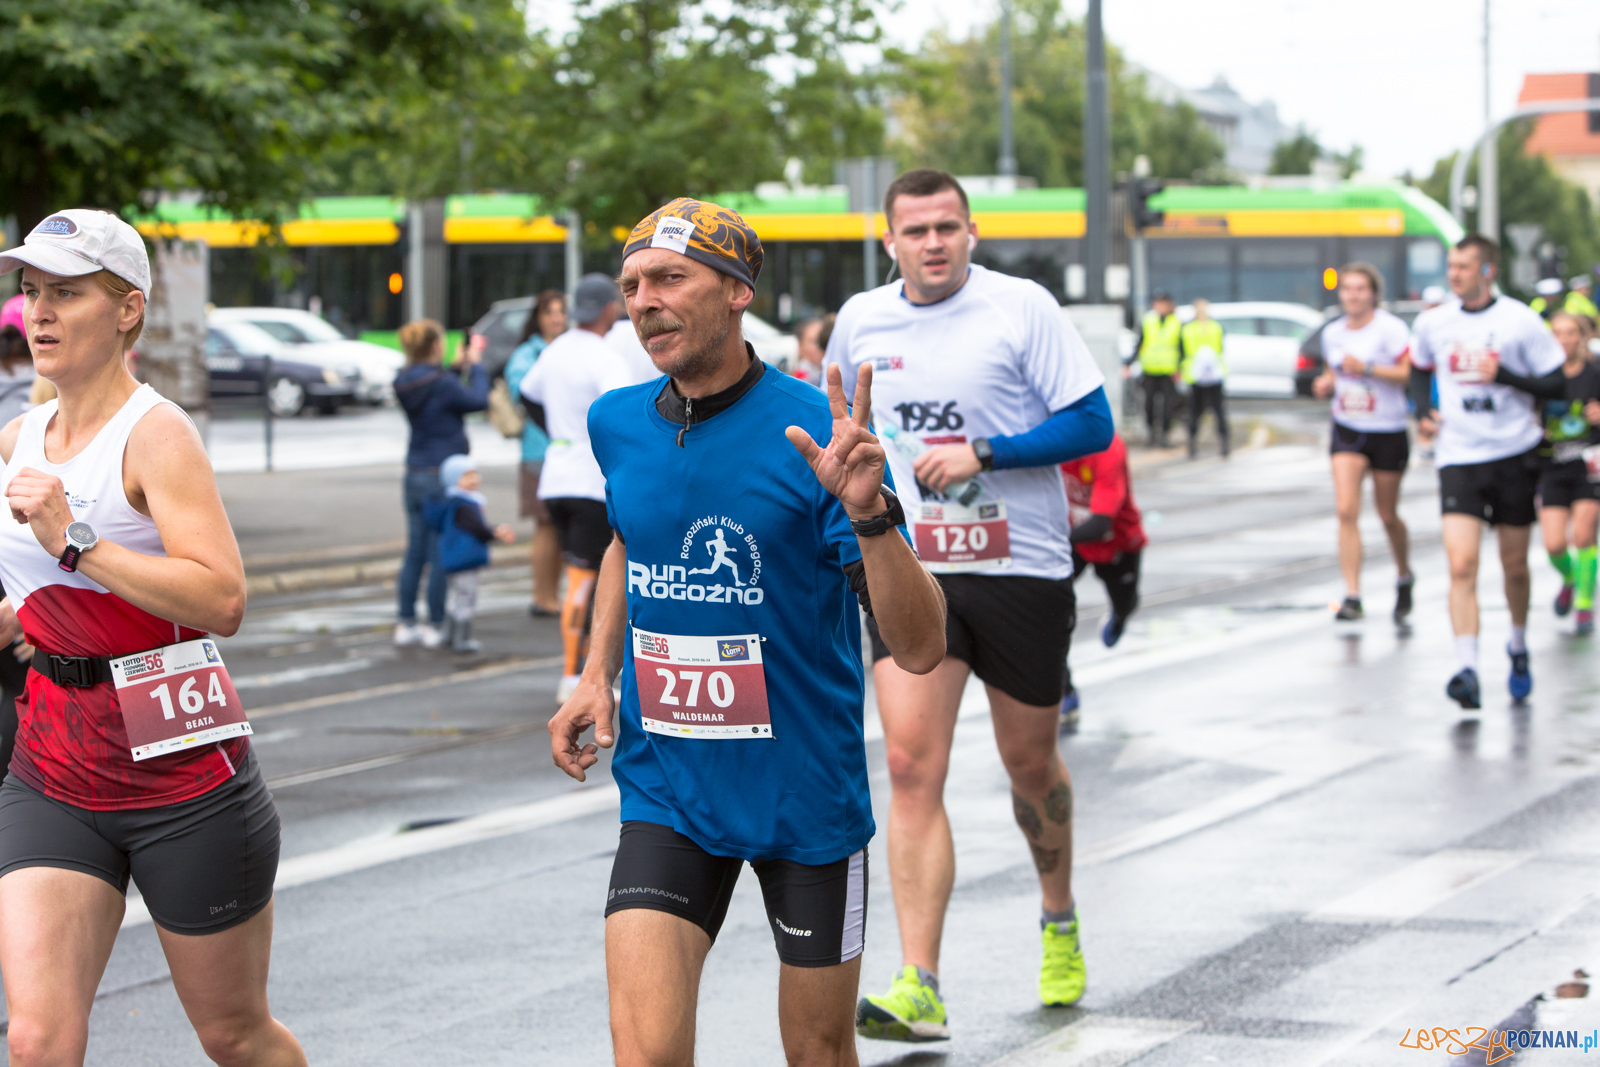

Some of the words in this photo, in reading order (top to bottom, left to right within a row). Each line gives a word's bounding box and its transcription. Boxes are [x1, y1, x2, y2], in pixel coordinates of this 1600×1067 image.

[893, 400, 965, 432] 1956
[720, 516, 745, 535] Klub
[744, 533, 762, 586] Biegacza
[931, 525, 988, 553] 120
[122, 656, 141, 667] LOTTO
[149, 672, 227, 720] 164
[655, 668, 735, 708] 270
[185, 716, 215, 730] BEATA
[672, 711, 725, 722] WALDEMAR
[617, 887, 689, 904] YARAPRAXAIR
